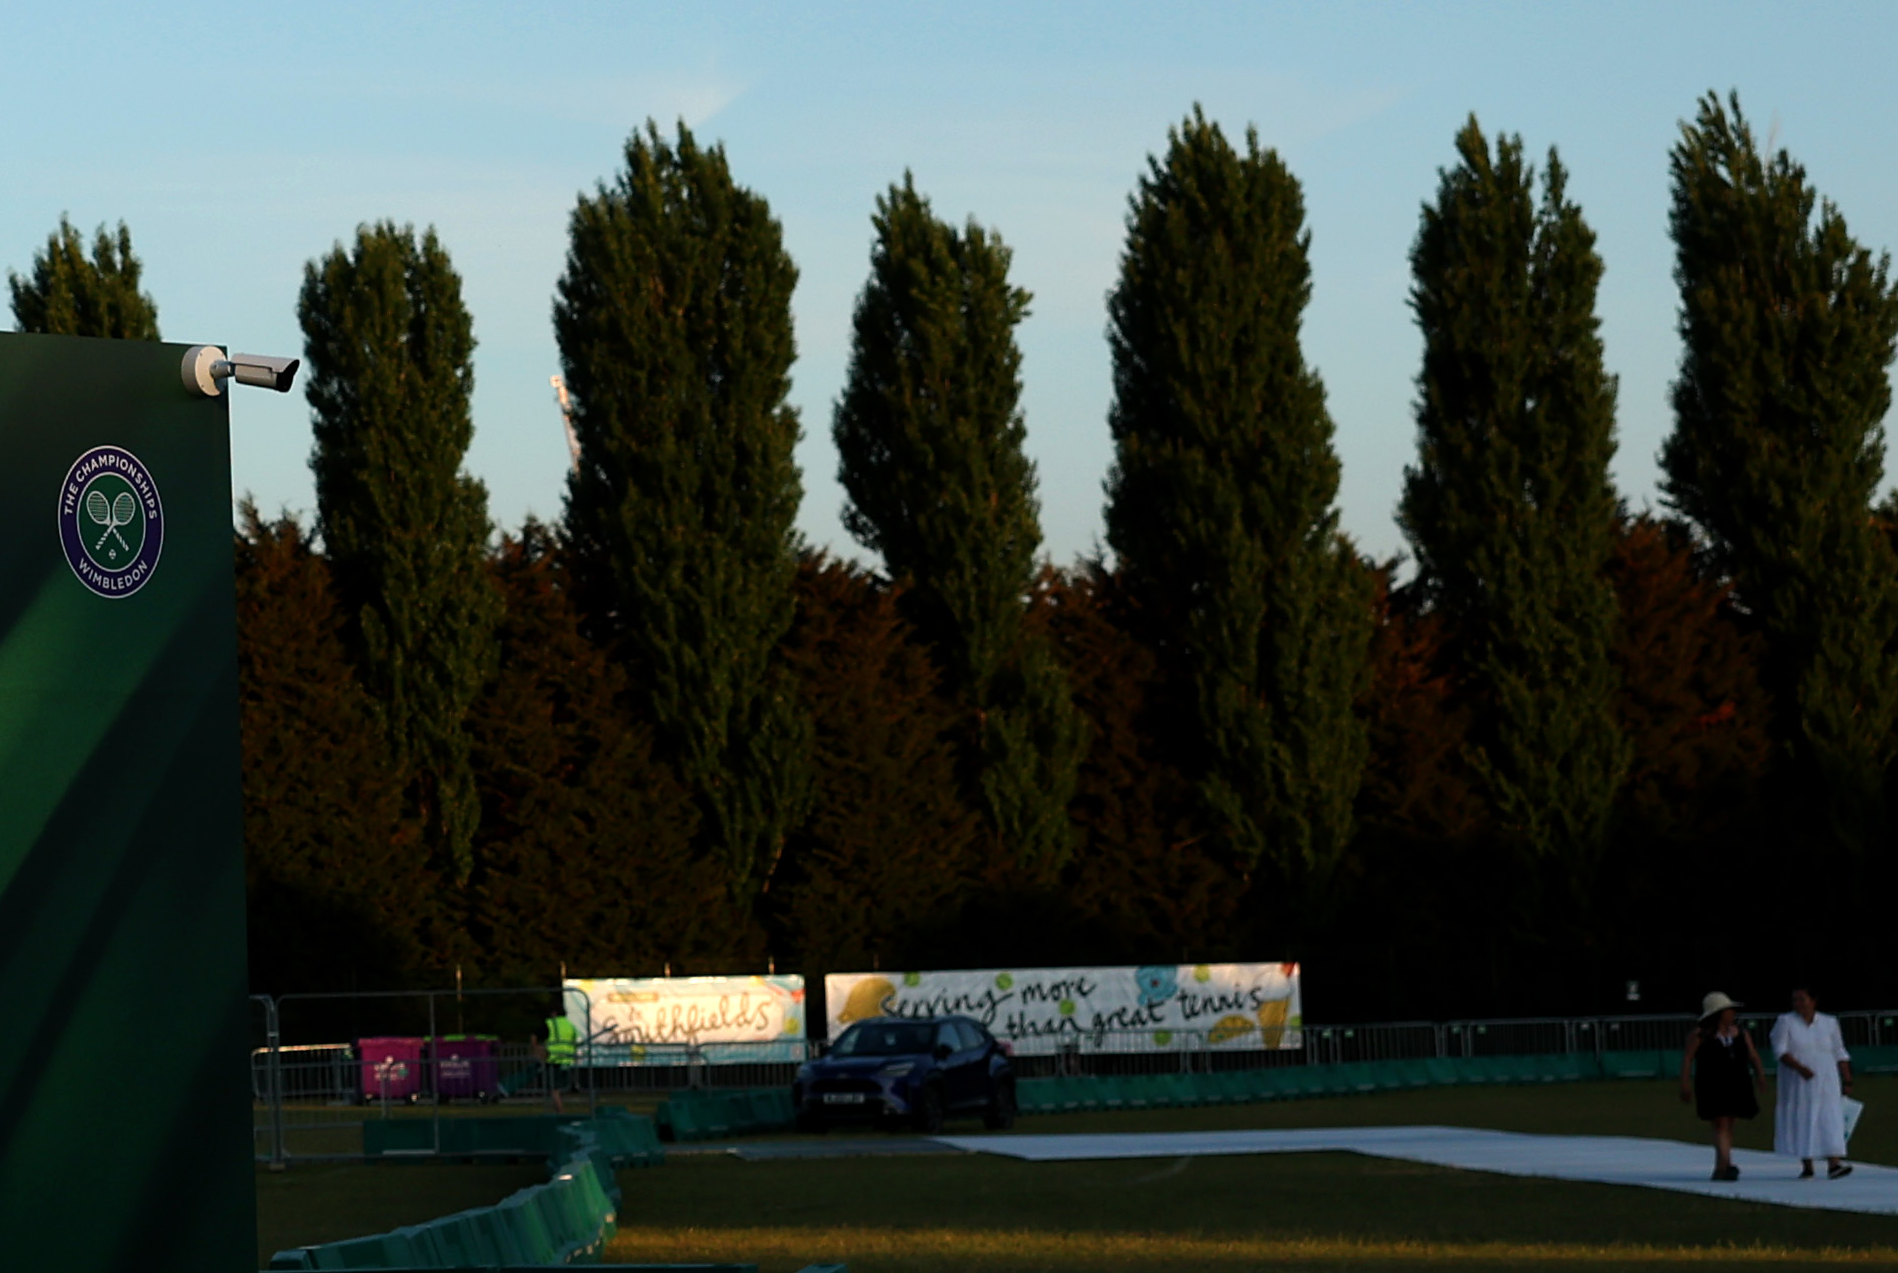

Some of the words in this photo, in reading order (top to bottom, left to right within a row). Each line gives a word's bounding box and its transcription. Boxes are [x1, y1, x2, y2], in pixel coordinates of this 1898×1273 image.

[64, 482, 79, 516] THE
[75, 454, 158, 520] CHAMPIONSHIPS
[78, 557, 148, 591] WIMBLEDON
[1007, 1013, 1082, 1040] than
[1088, 999, 1165, 1047] great
[1176, 984, 1263, 1020] tennis
[1021, 976, 1097, 1004] more
[603, 991, 772, 1046] Southfields
